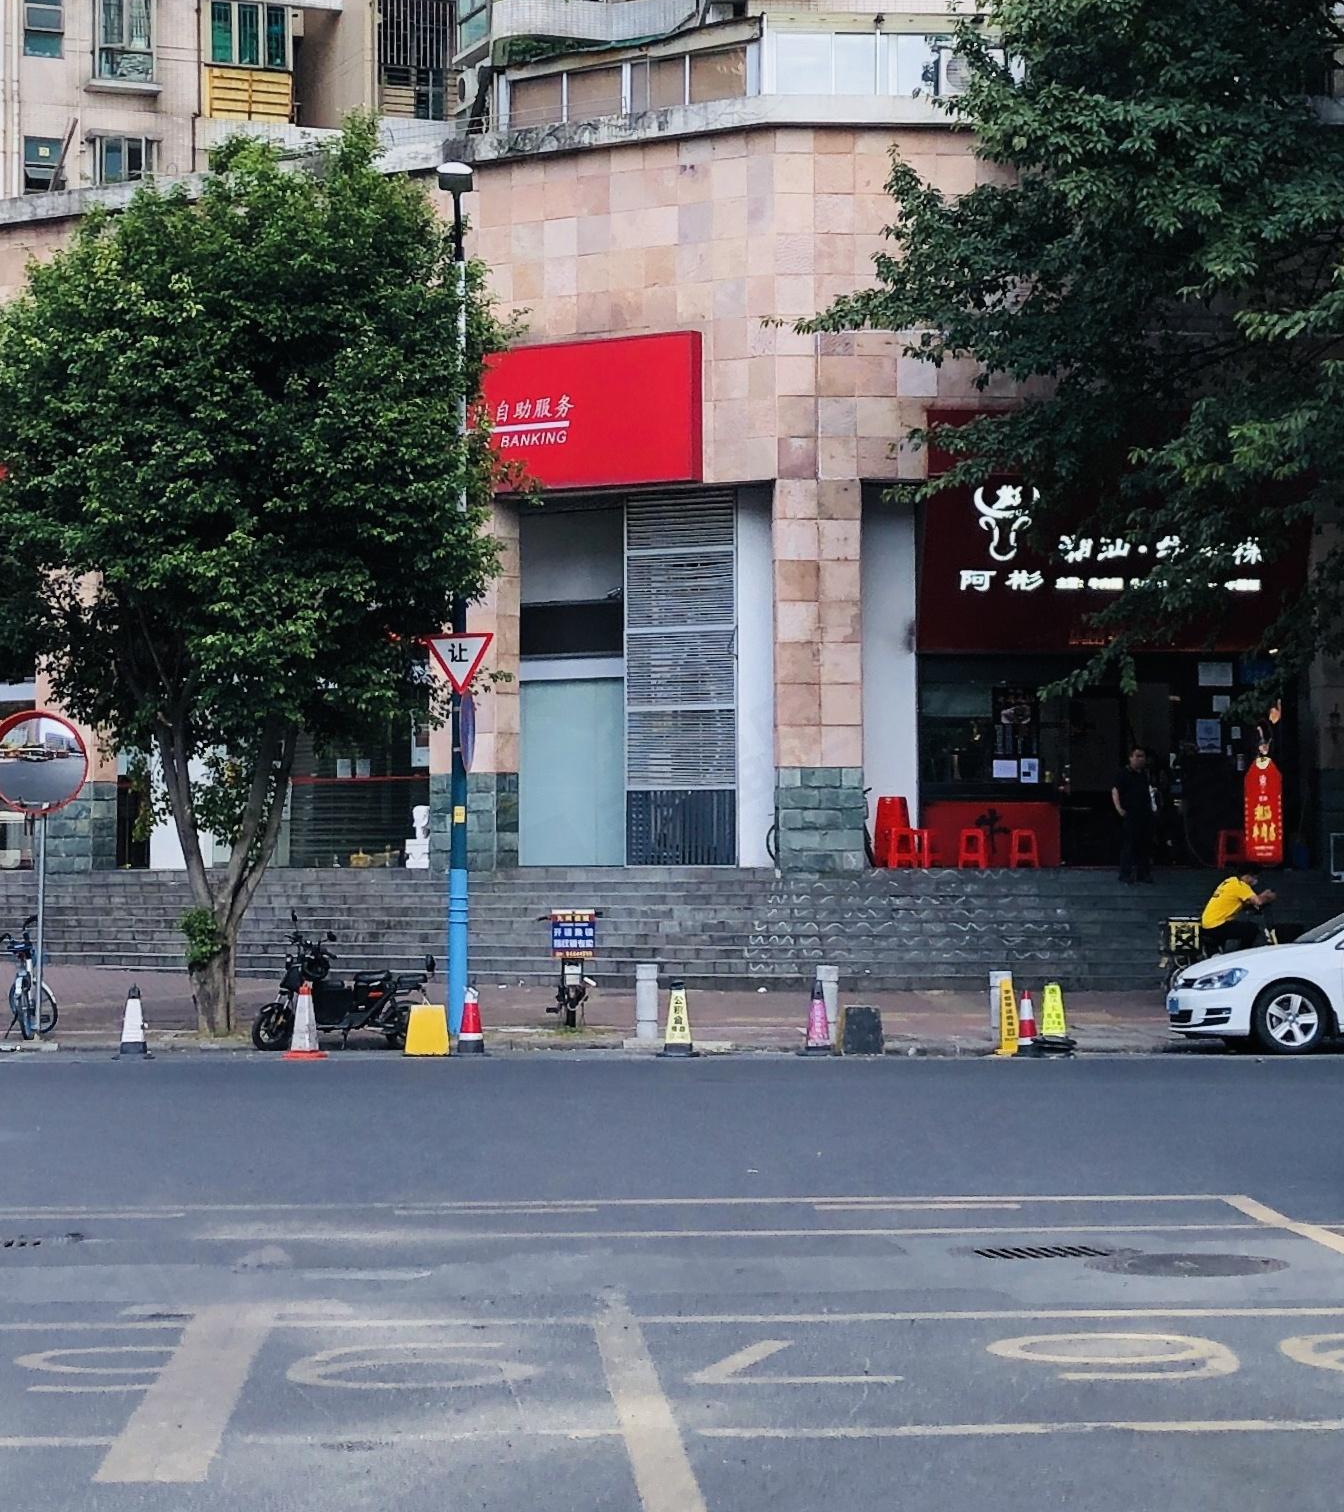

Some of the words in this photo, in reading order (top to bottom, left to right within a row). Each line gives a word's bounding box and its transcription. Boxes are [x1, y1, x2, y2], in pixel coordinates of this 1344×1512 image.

[496, 394, 575, 423] 自助服务
[500, 430, 568, 448] BANKING
[447, 642, 470, 664] 让
